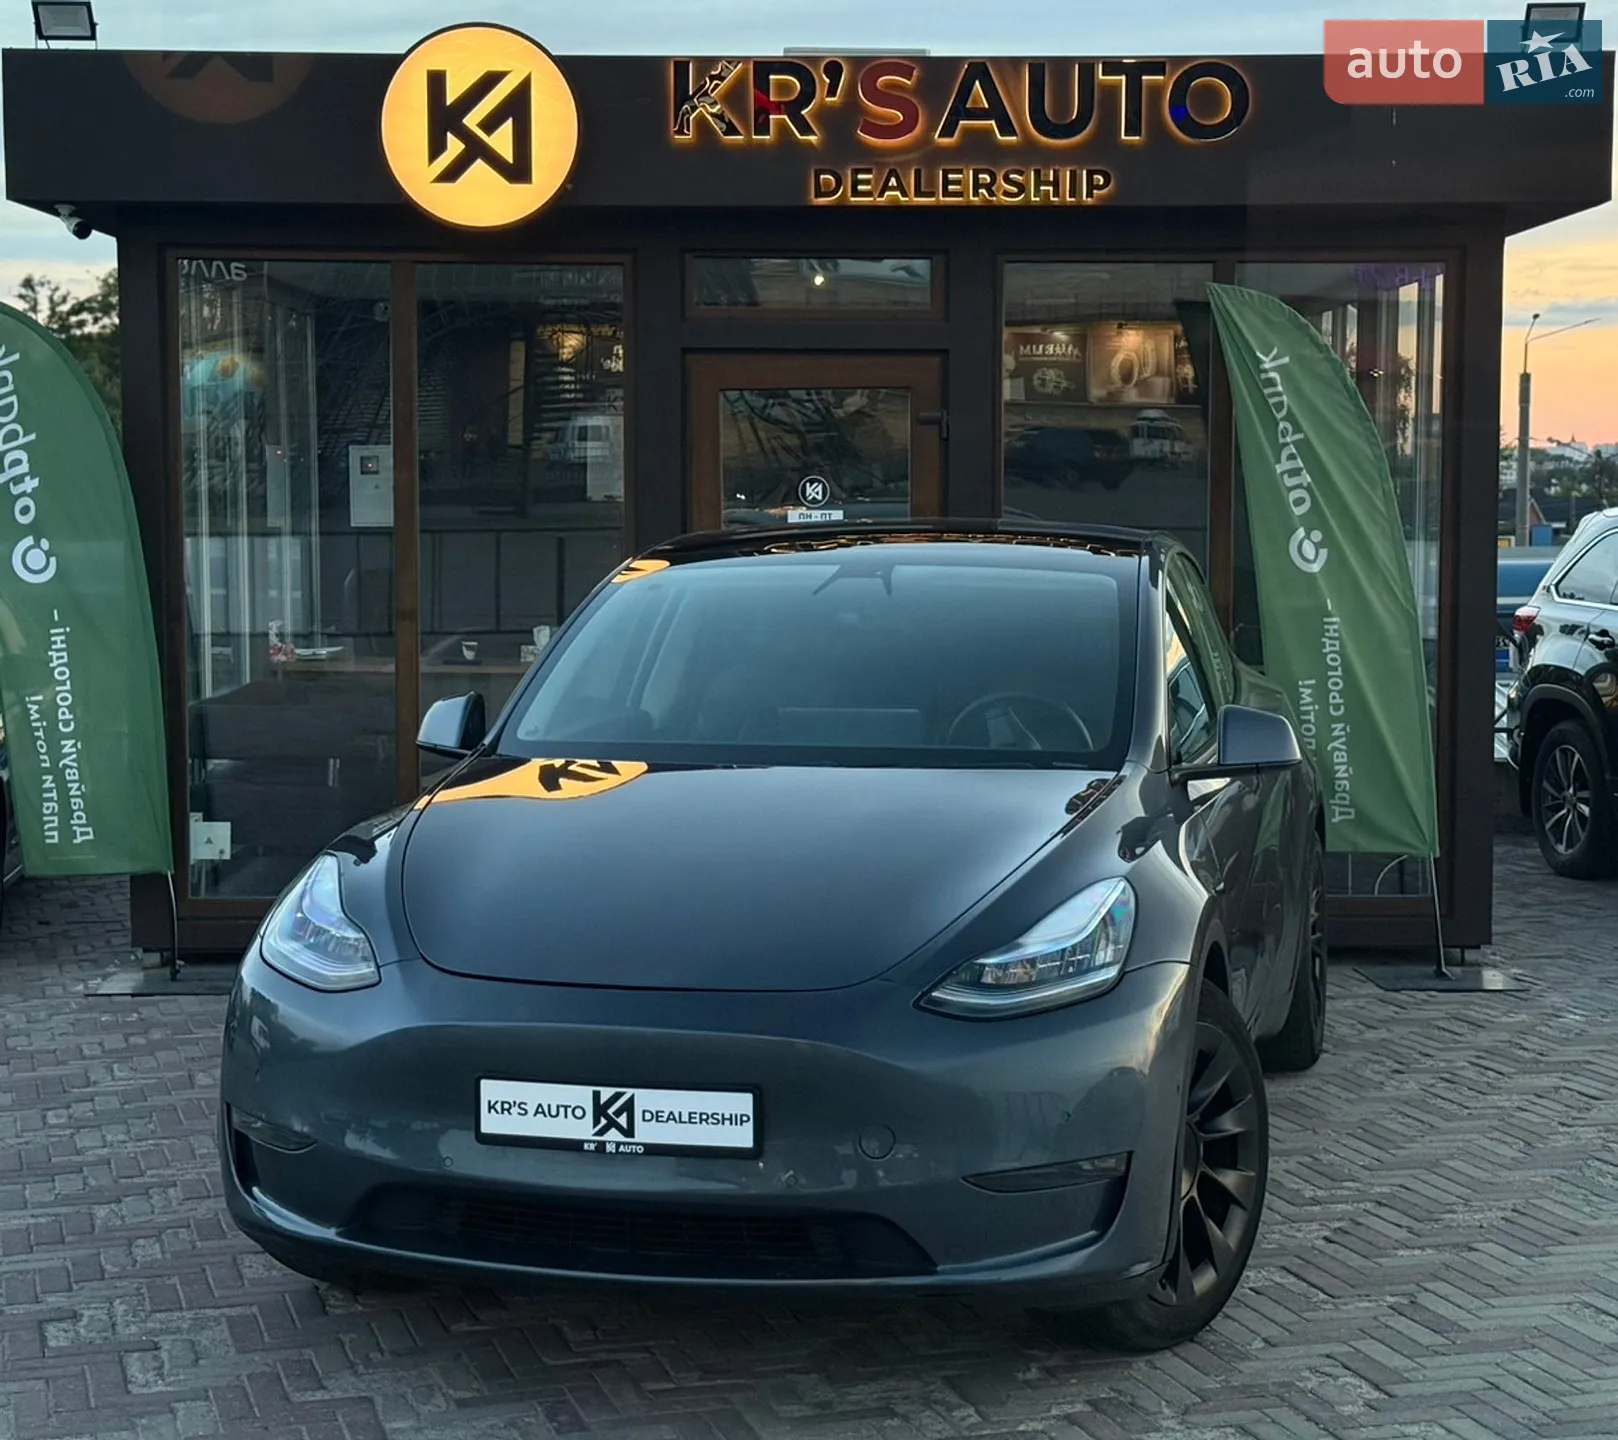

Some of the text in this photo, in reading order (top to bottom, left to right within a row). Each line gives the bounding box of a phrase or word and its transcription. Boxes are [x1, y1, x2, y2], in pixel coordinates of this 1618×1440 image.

[672, 58, 1251, 141] KR'S AUTO
[813, 167, 1113, 201] DEALERSHIP
[487, 1099, 528, 1117] KR'S
[533, 1102, 586, 1121] AUTO
[641, 1108, 751, 1127] DEALERSHIP
[618, 1144, 645, 1154] AUTO
